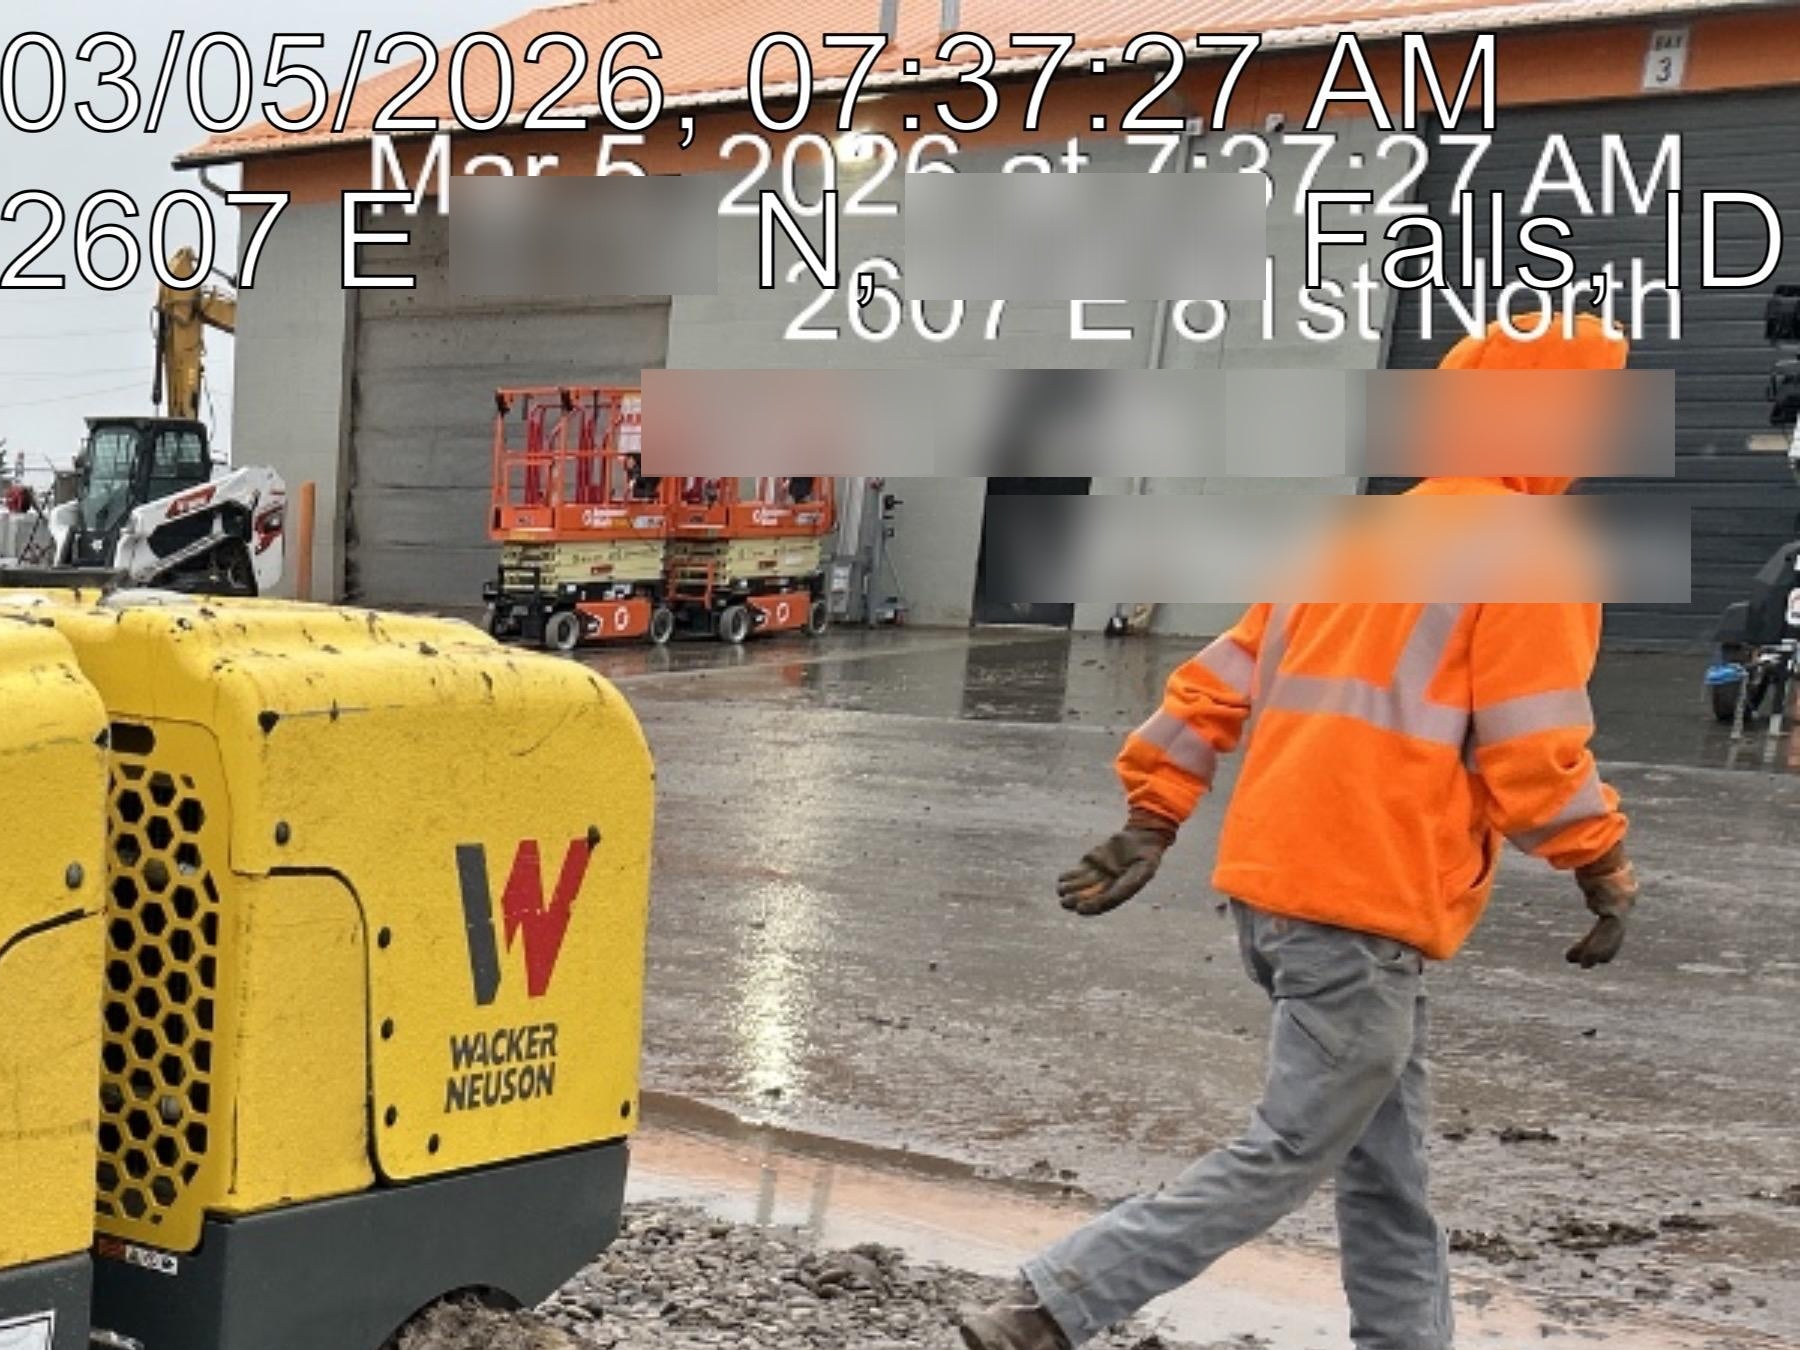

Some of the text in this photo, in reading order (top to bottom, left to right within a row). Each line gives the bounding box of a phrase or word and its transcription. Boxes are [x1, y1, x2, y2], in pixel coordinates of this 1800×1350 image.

[1656, 56, 1672, 82] 3
[449, 1021, 559, 1071] WACKER
[443, 1062, 556, 1114] NEUSON
